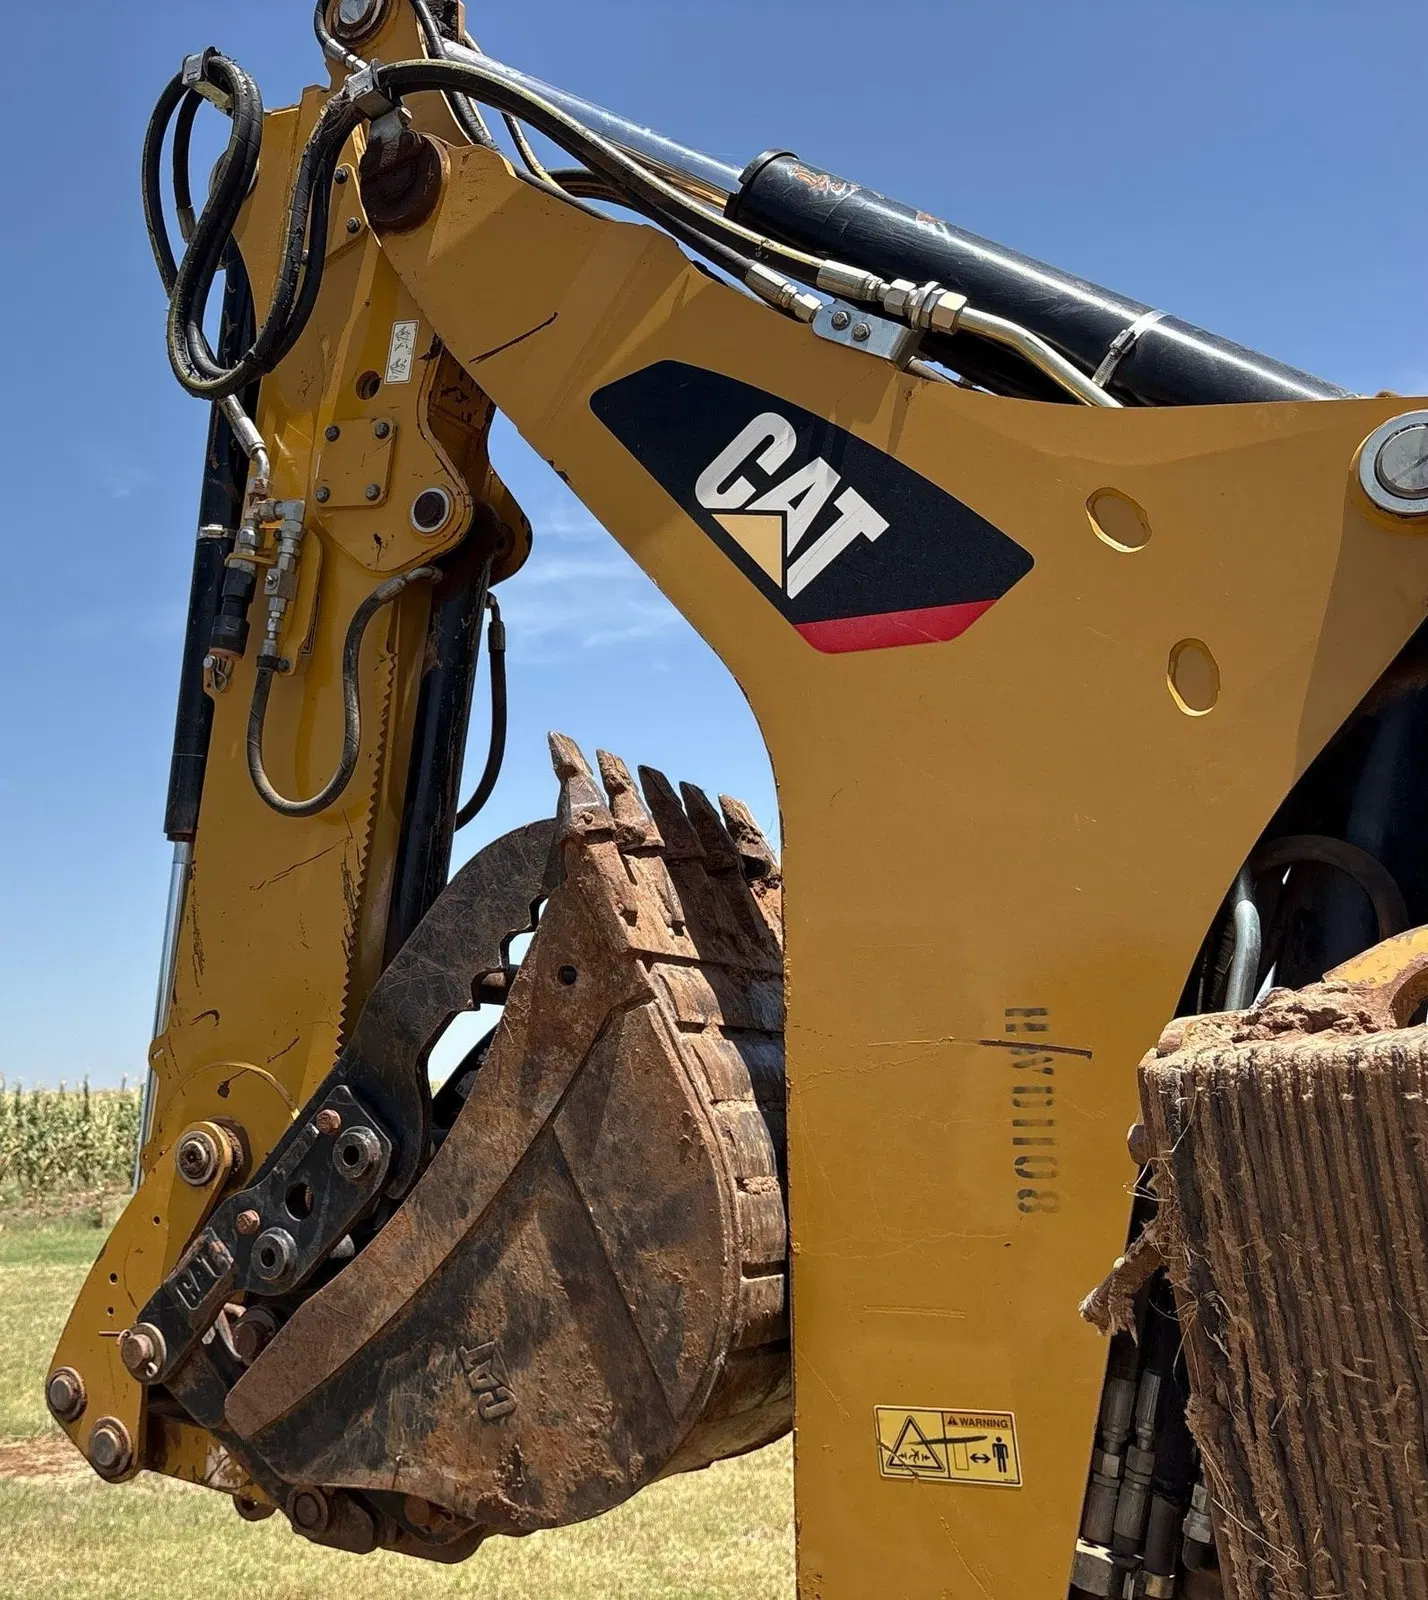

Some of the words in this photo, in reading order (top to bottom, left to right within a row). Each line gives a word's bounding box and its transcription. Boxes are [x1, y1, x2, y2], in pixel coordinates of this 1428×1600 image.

[695, 412, 890, 600] CAT
[459, 1341, 517, 1420] CAT
[959, 1417, 1009, 1429] WARNING
